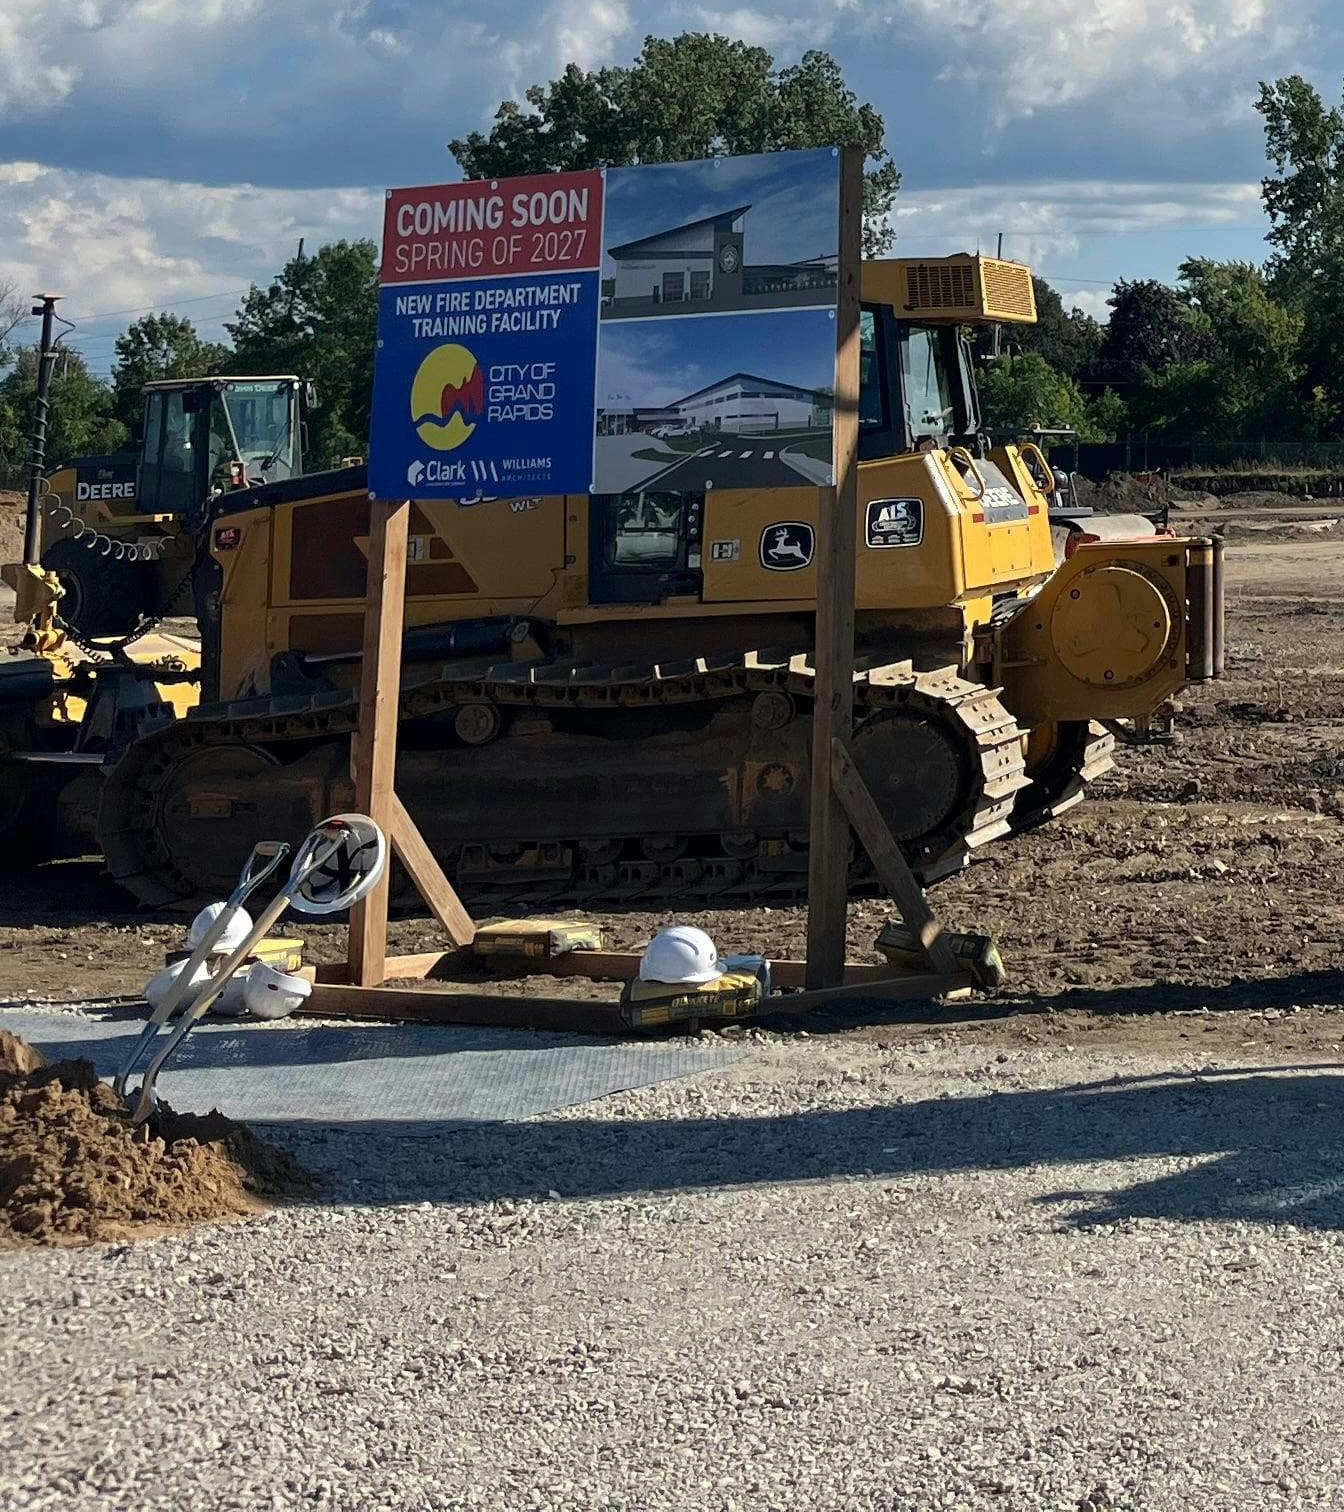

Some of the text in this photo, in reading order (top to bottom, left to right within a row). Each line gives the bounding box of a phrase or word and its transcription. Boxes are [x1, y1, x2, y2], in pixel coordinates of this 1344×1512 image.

[396, 188, 589, 237] COMING SOON
[395, 229, 587, 273] SPRING OF 2027
[396, 284, 581, 316] NEW FIRE DEPARTMENT
[412, 309, 562, 338] TRAINING FACILITY
[489, 362, 556, 382] CITY OF
[489, 383, 556, 402] GRAND
[488, 403, 553, 422] RAPIDS
[426, 457, 552, 481] Clark WILLIAMS
[77, 482, 135, 500] DEERE
[878, 501, 908, 521] AIS
